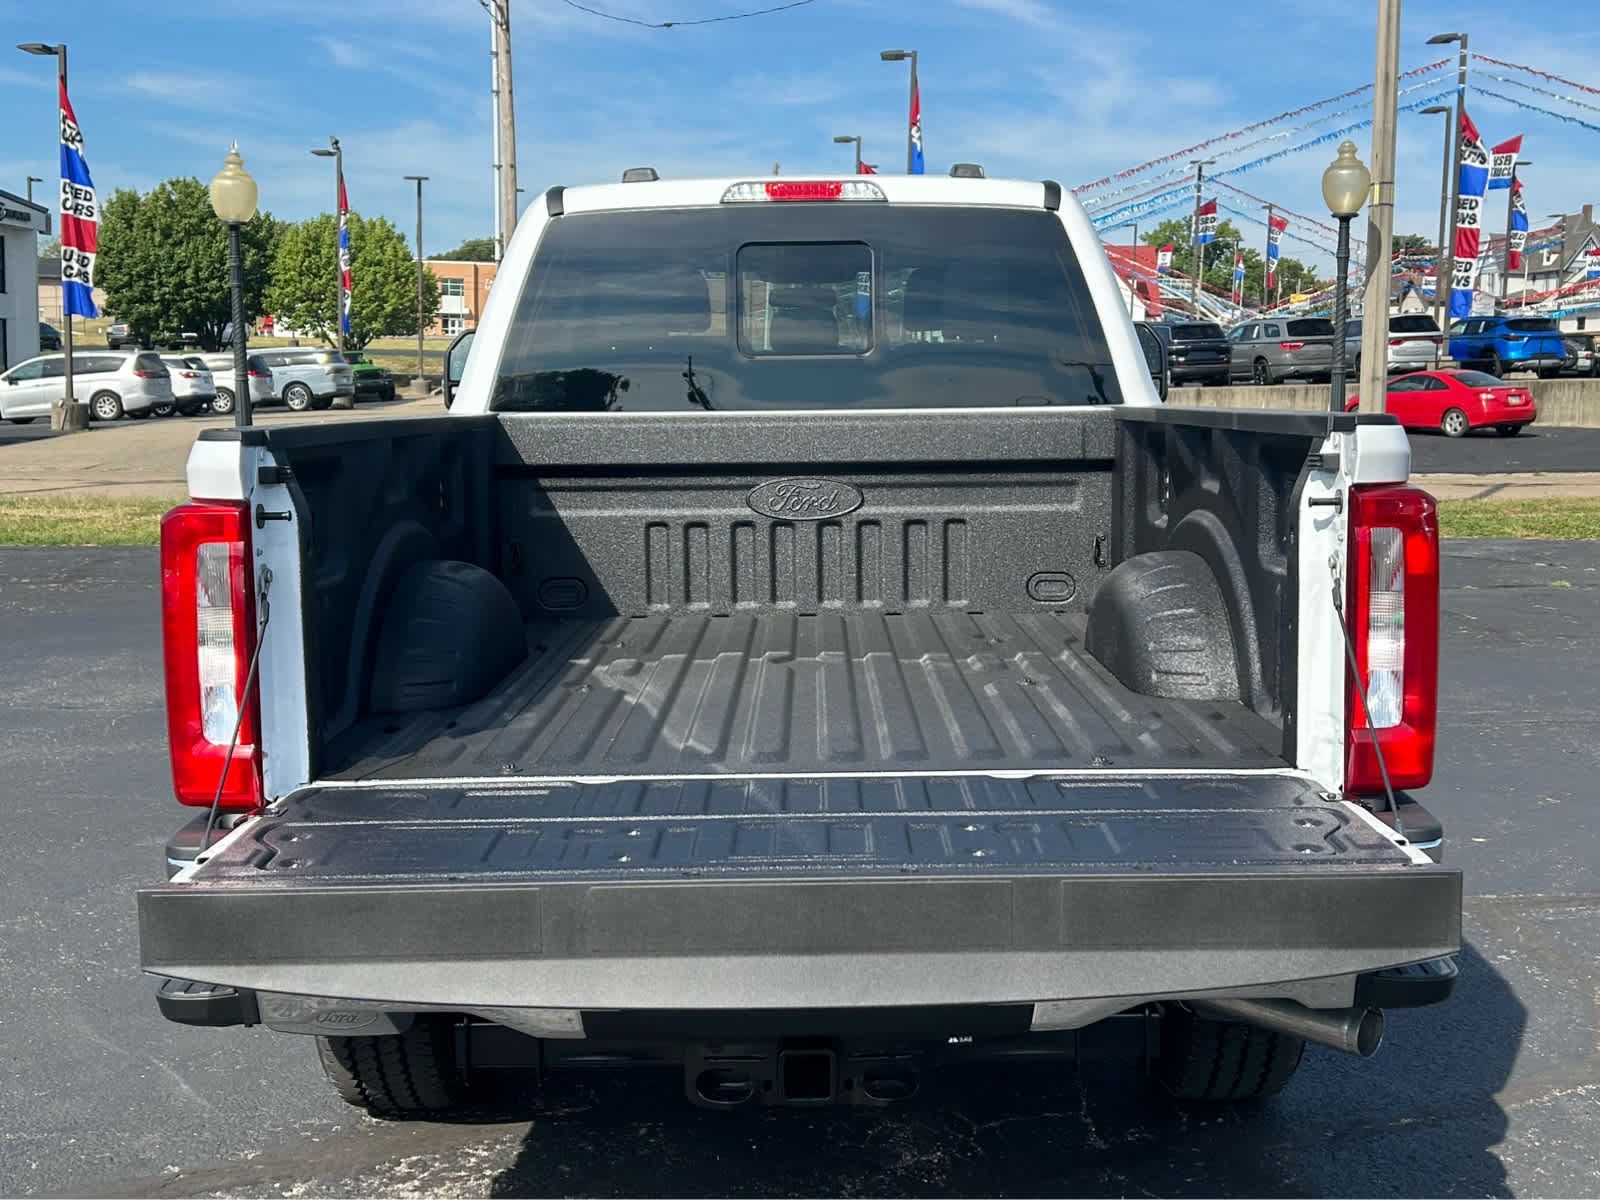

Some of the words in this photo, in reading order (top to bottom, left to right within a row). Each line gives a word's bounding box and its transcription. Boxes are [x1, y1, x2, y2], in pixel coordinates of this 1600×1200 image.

[62, 182, 93, 202] UED
[62, 198, 95, 217] CRS
[1457, 198, 1479, 211] SED
[1199, 216, 1217, 225] SED
[63, 249, 90, 268] UED
[1454, 260, 1473, 273] ED
[63, 264, 91, 284] CAS
[768, 482, 840, 513] Ford
